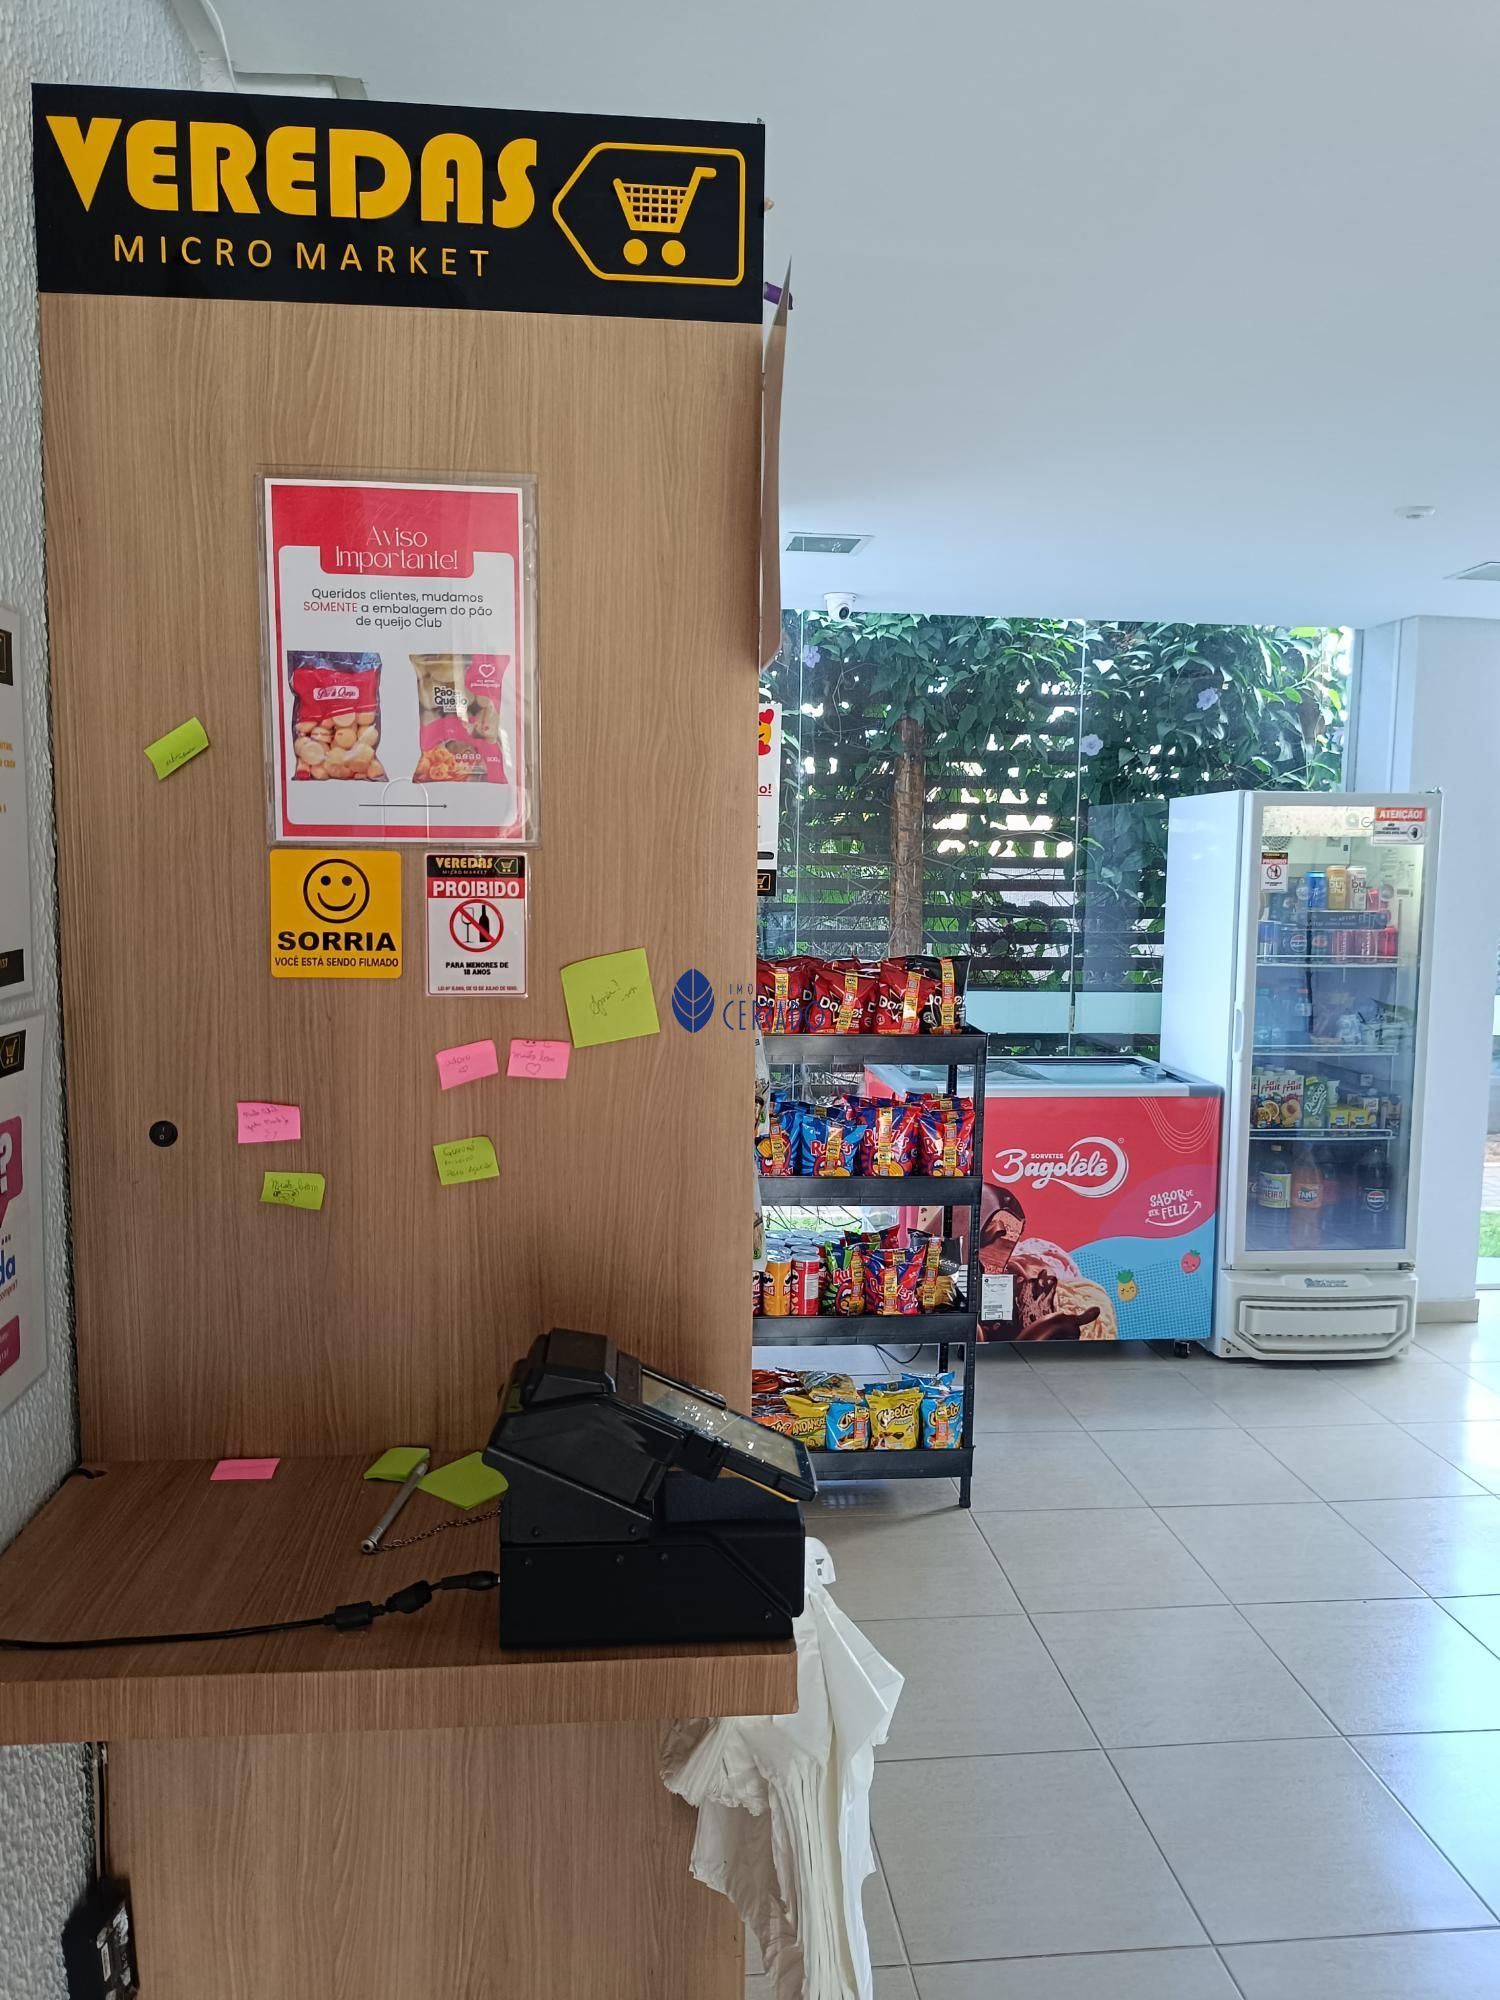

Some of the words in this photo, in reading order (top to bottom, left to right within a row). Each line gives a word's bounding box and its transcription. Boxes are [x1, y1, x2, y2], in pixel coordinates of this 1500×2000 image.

[46, 114, 538, 230] VEREDAS
[113, 233, 274, 269] MICRO
[296, 240, 490, 278] MARKET
[366, 525, 428, 548] Aviso
[336, 546, 458, 574] Importante!
[311, 588, 366, 601] Queridos
[369, 590, 419, 602] clientes,
[421, 592, 484, 603] mudamos
[303, 602, 358, 613] SOMENTE
[360, 606, 369, 614] a
[372, 604, 447, 618] embalagem
[450, 604, 466, 616] do
[469, 605, 493, 618] pão
[355, 616, 371, 627] de
[374, 616, 412, 630] queijo
[414, 616, 442, 628] Club
[435, 857, 493, 869] VEREDAS
[432, 880, 520, 897] PROIBIDO
[277, 930, 397, 952] SORRIA
[274, 954, 299, 967] VOCÊ
[301, 955, 324, 967] ESTÁ
[326, 957, 357, 967] SENDO
[359, 957, 399, 968] FILMADO
[445, 961, 465, 969] PARA
[465, 961, 498, 969] MENORES
[499, 961, 509, 969] DE
[463, 968, 471, 976] 18
[472, 968, 491, 976] ANOS
[1150, 1188, 1187, 1207] SABOR
[1161, 1203, 1189, 1220] FELIZ
